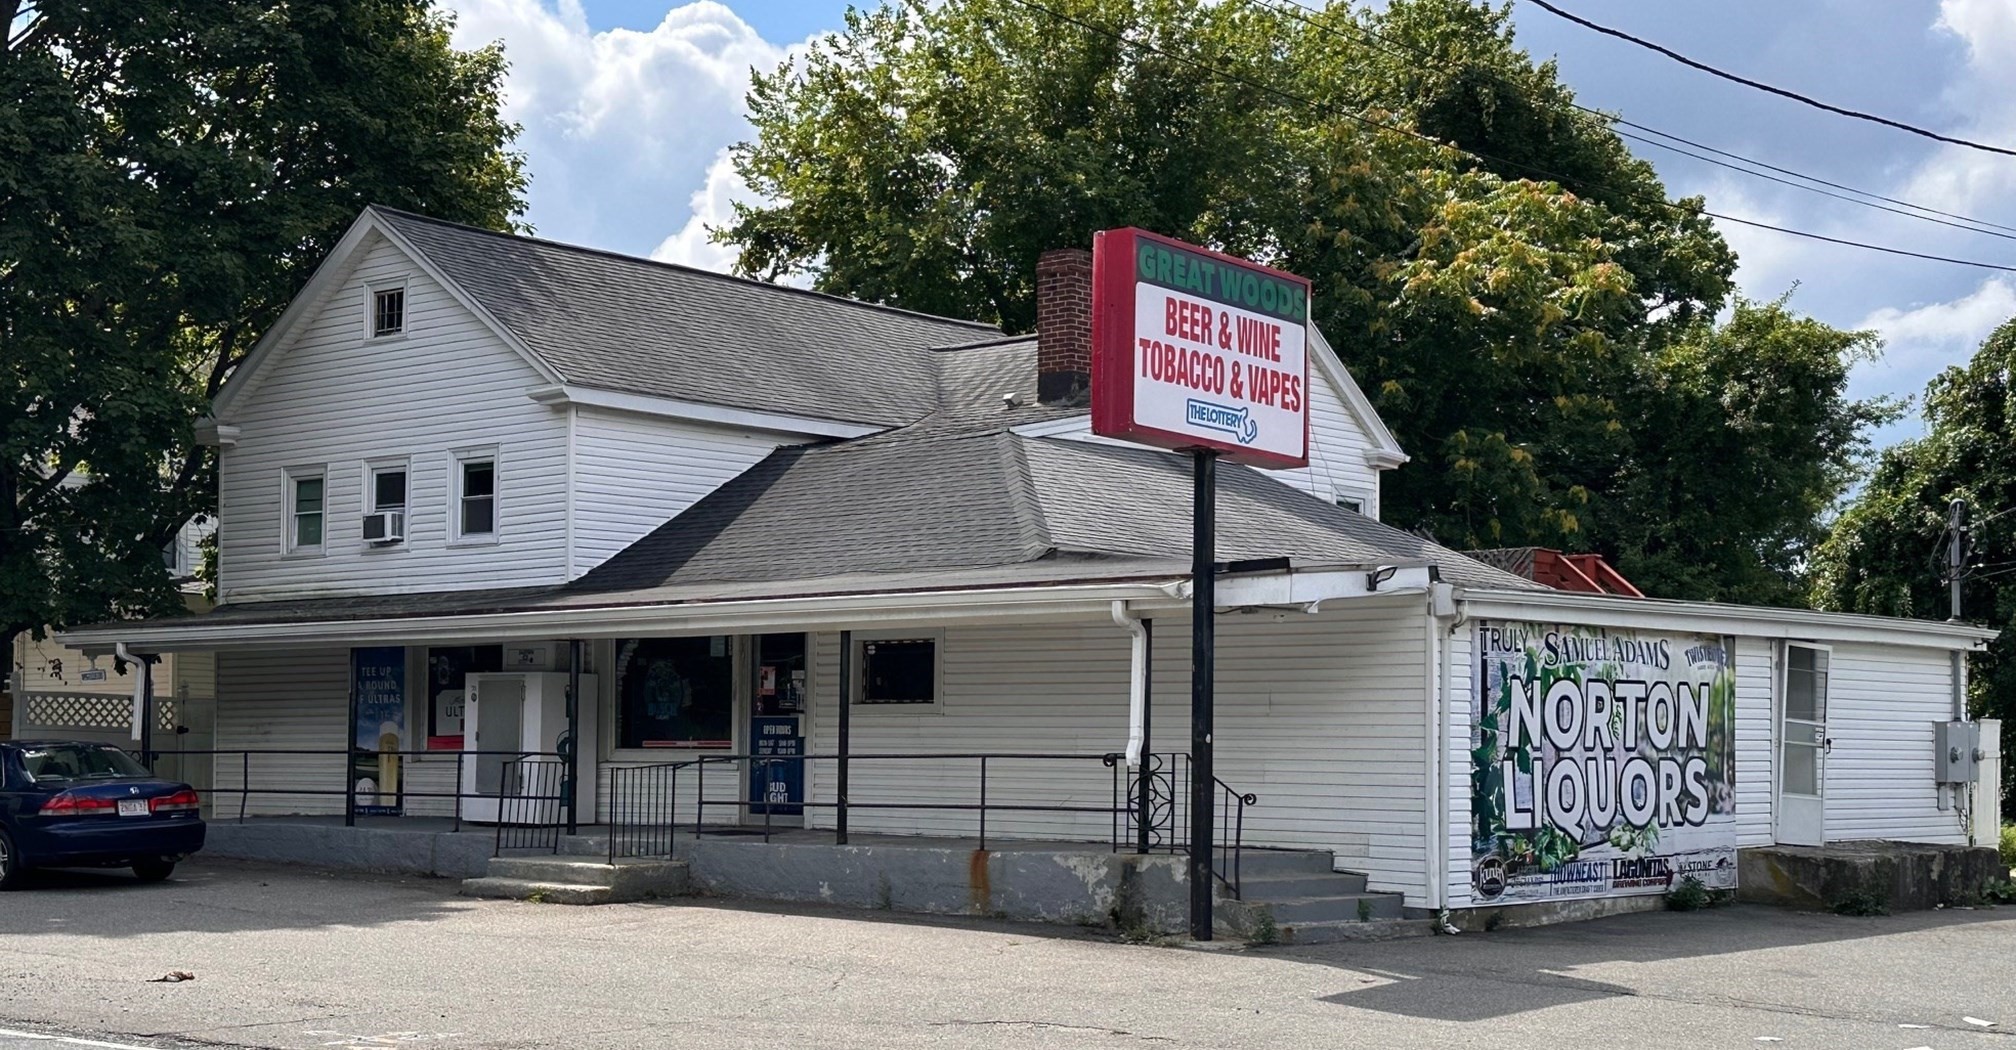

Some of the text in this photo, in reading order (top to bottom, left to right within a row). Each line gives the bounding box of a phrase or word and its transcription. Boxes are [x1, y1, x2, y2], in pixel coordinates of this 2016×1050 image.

[1138, 245, 1306, 319] GREAT WOODS
[1165, 296, 1281, 362] BEER & WINE
[1139, 337, 1301, 412] TOBACCO & VAPES
[1480, 627, 1529, 653] TRULY
[1544, 632, 1671, 670] SAMUEL ADAMS
[361, 666, 392, 677] TEE UP
[366, 681, 397, 690] ROUND
[368, 694, 401, 704] ULTRAS
[1508, 675, 1711, 752] NORTON
[1502, 755, 1710, 845] LIQUORS
[1553, 862, 1604, 884] DOWNEAST
[1612, 857, 1669, 880] LAGUNITAS
